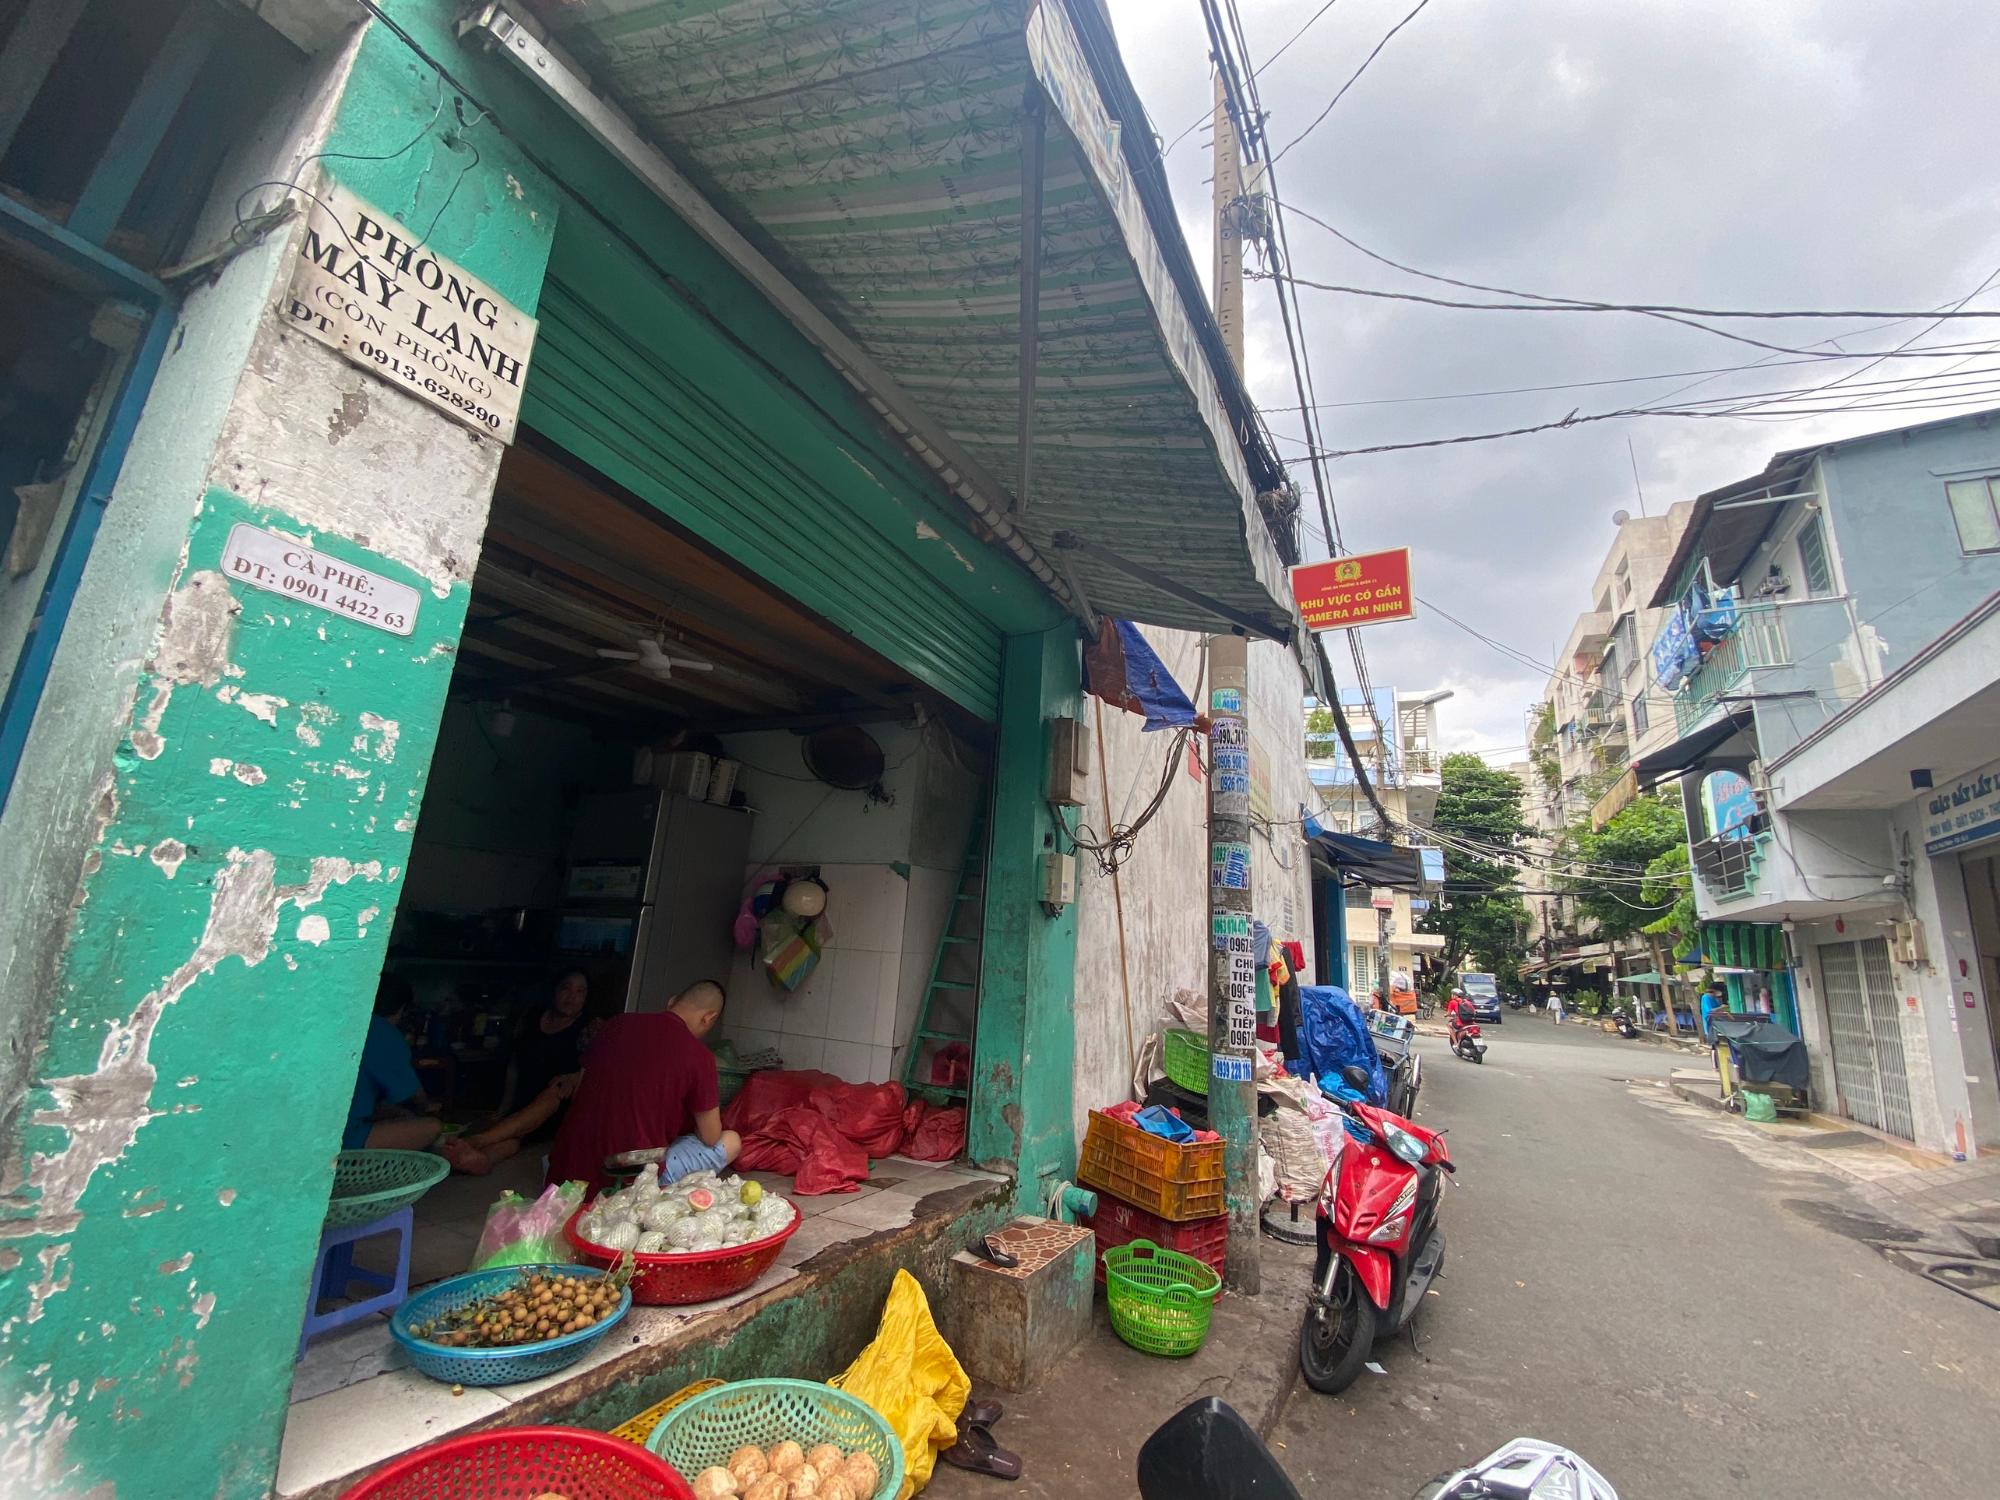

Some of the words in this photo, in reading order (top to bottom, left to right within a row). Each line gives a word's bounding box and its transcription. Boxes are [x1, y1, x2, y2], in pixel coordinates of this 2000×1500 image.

[301, 227, 404, 311] MÁY
[411, 300, 523, 387] LẠNH
[350, 212, 498, 331] PHÒNG
[315, 285, 388, 336] (CÒN
[394, 330, 492, 399] PHÒNG)
[359, 341, 501, 429] 0913.628290
[232, 556, 276, 584] ĐT:
[283, 575, 329, 602] 0901
[336, 594, 379, 620] 4422
[384, 612, 405, 629] 63
[283, 551, 316, 575] CÀ
[323, 566, 375, 596] PHÊ:
[1300, 598, 1325, 611] KHU
[1328, 593, 1352, 606] VỰC
[1355, 588, 1372, 601] CÓ
[1302, 609, 1349, 623] CAMERA
[1352, 605, 1369, 617] AN
[1373, 600, 1403, 614] NINH
